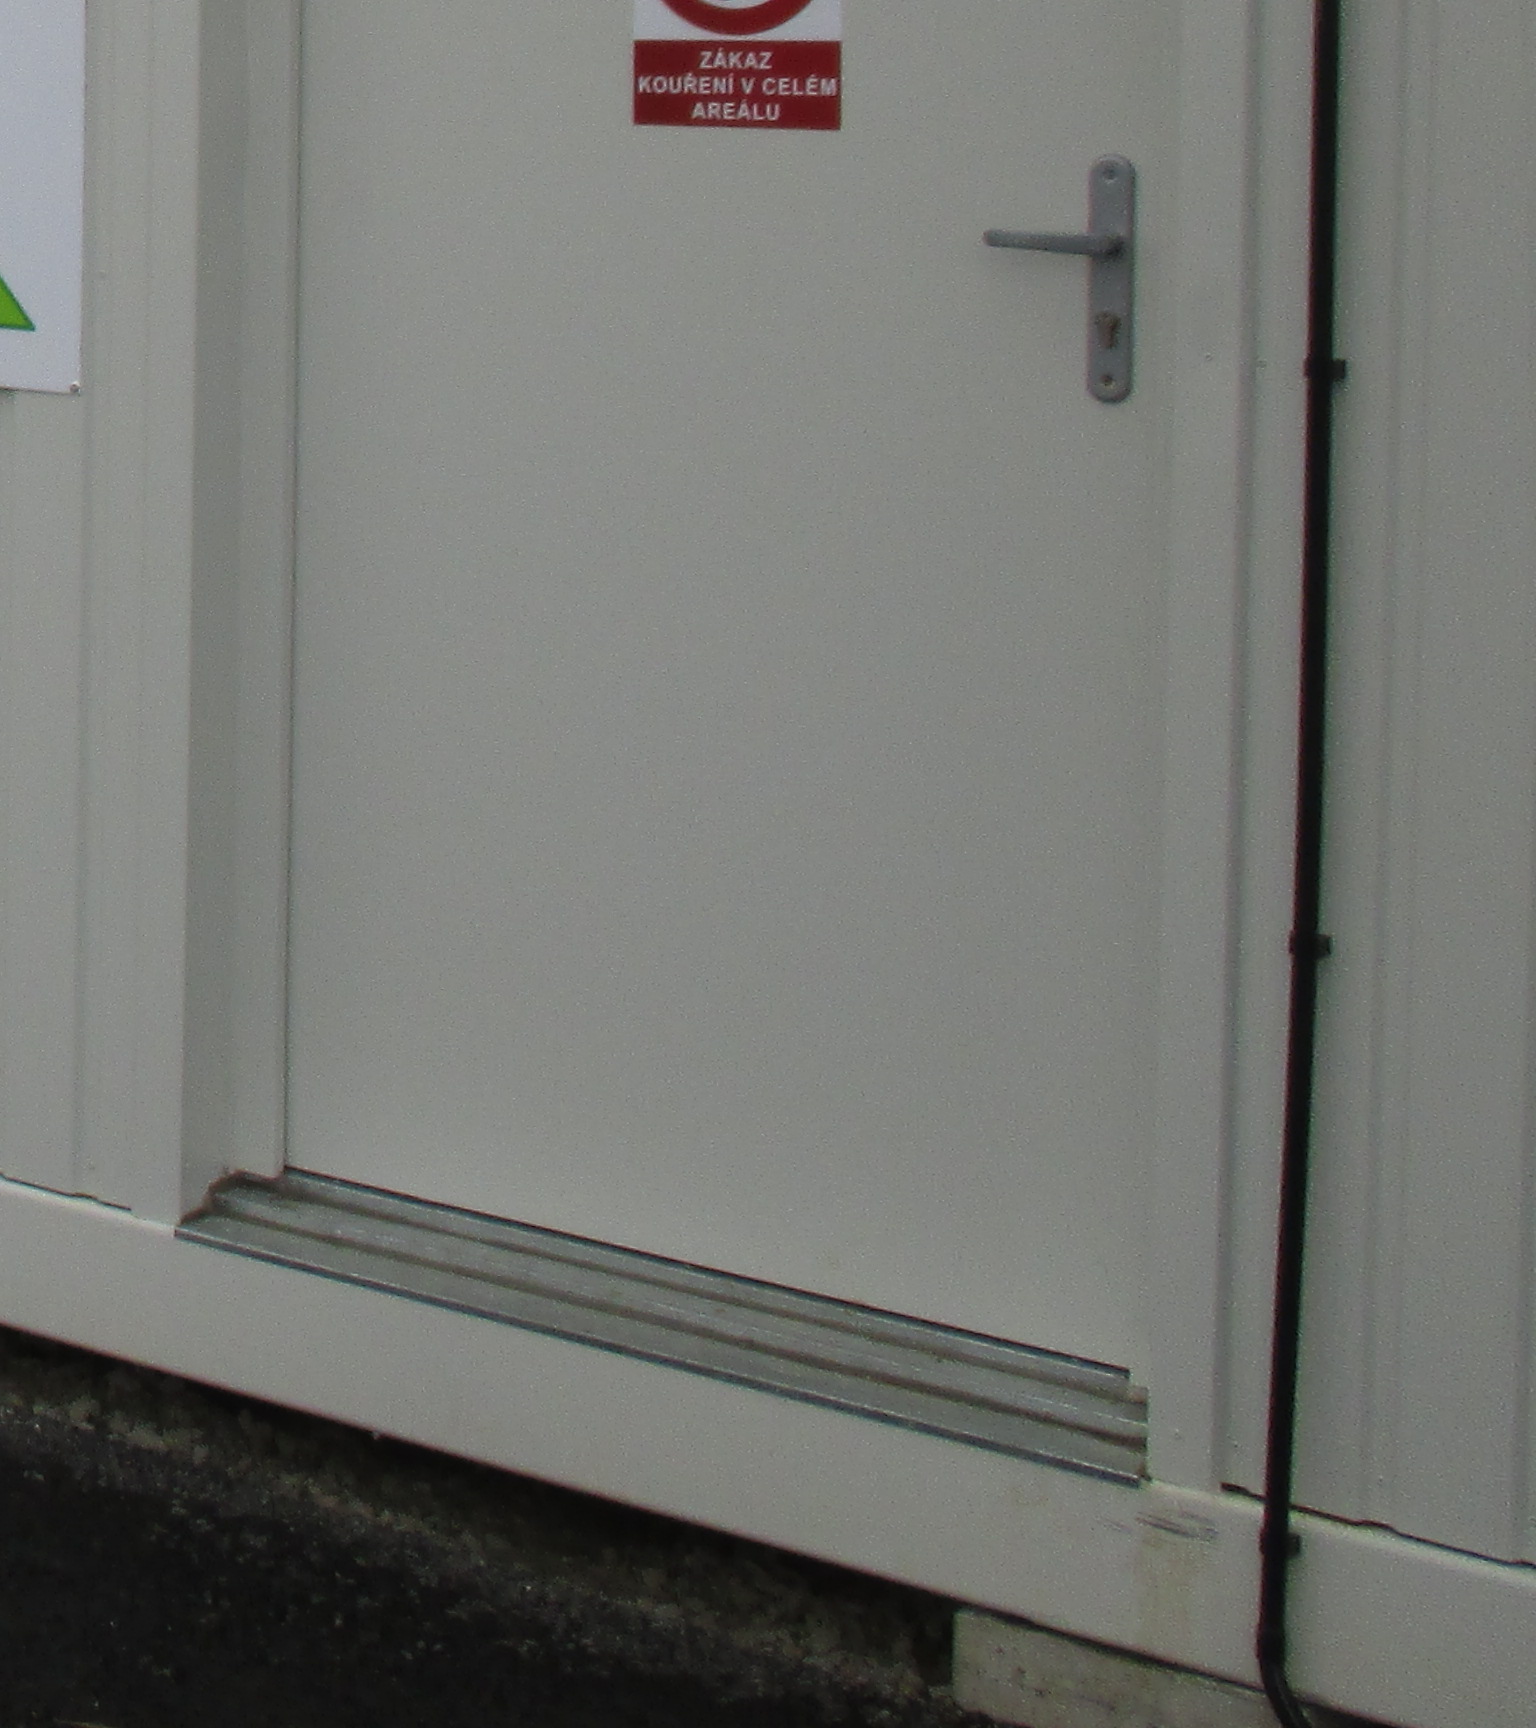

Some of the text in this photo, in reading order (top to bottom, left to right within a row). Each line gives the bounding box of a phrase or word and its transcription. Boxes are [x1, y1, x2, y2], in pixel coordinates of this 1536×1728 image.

[698, 47, 774, 70] ZÁKAZ
[637, 72, 838, 96] KOUŘENÍ V CELÉM
[691, 98, 781, 121] AREÁLU
